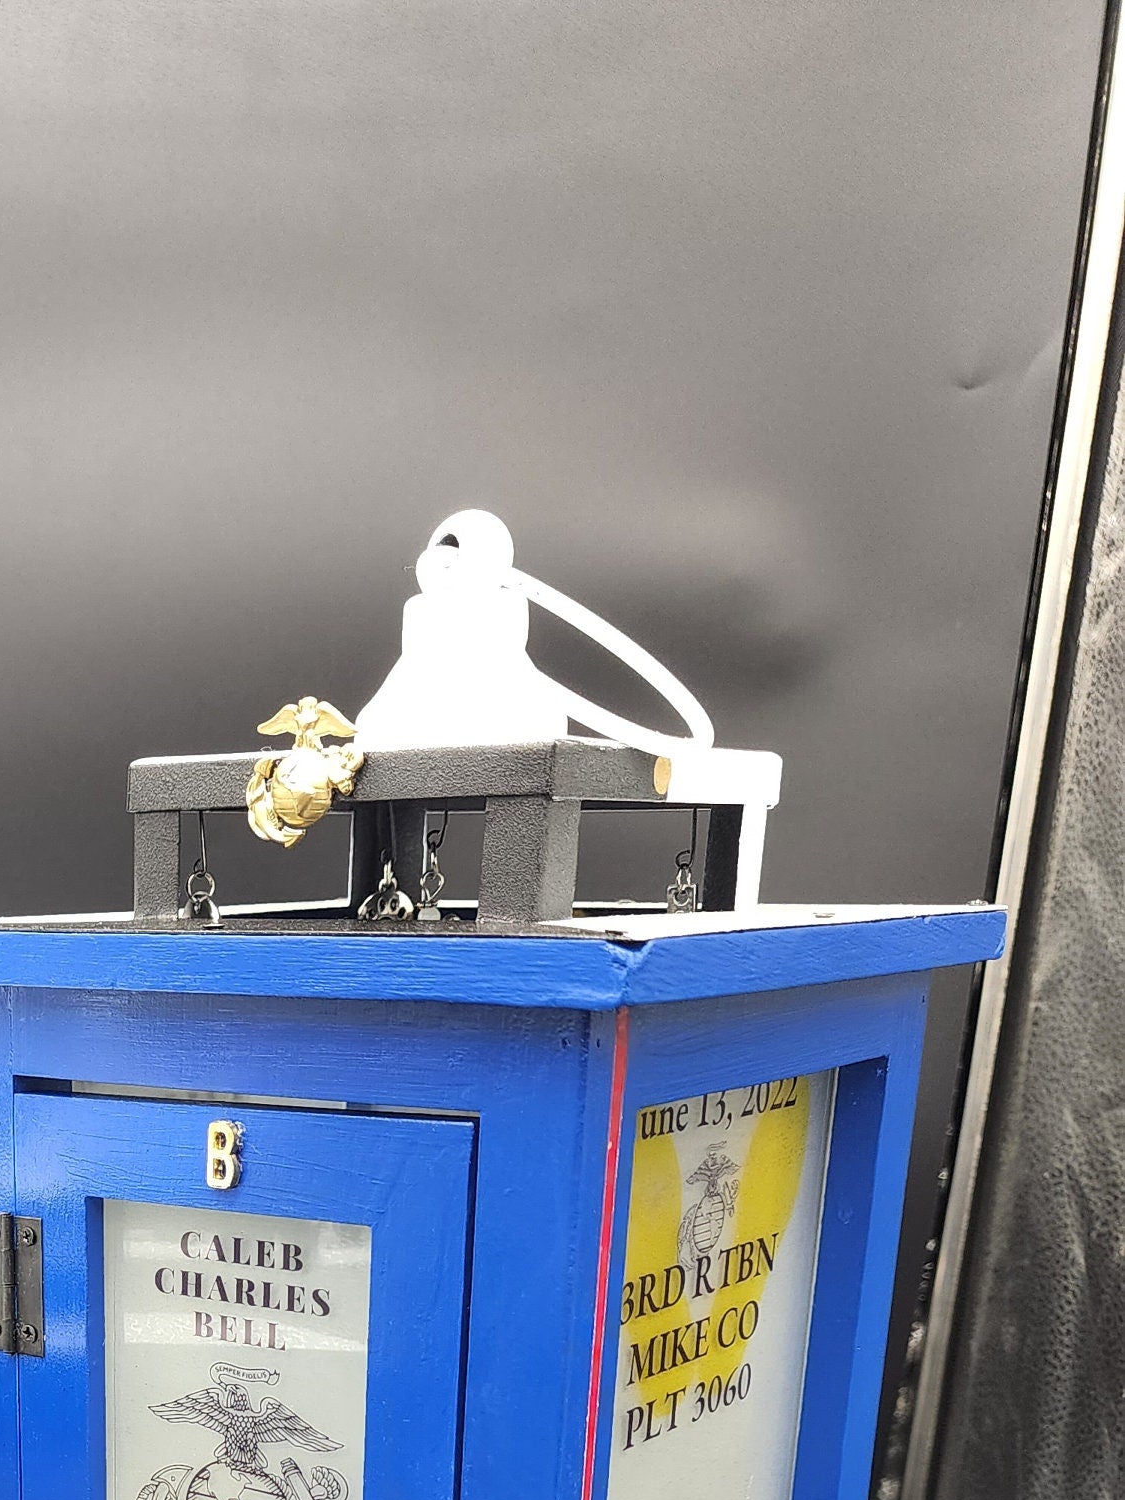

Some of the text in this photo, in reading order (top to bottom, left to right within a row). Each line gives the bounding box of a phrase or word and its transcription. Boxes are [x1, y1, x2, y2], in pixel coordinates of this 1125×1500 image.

[741, 1077, 798, 1117] 2022
[206, 1120, 242, 1190] B
[180, 1231, 303, 1272] CALEB
[154, 1267, 331, 1316] CHARLES
[620, 1265, 686, 1325] 3RD
[194, 1311, 286, 1351] BELL
[626, 1300, 759, 1386] MIKE CO
[215, 1366, 241, 1376] SEMPER
[623, 1363, 751, 1450] PLT 3060
